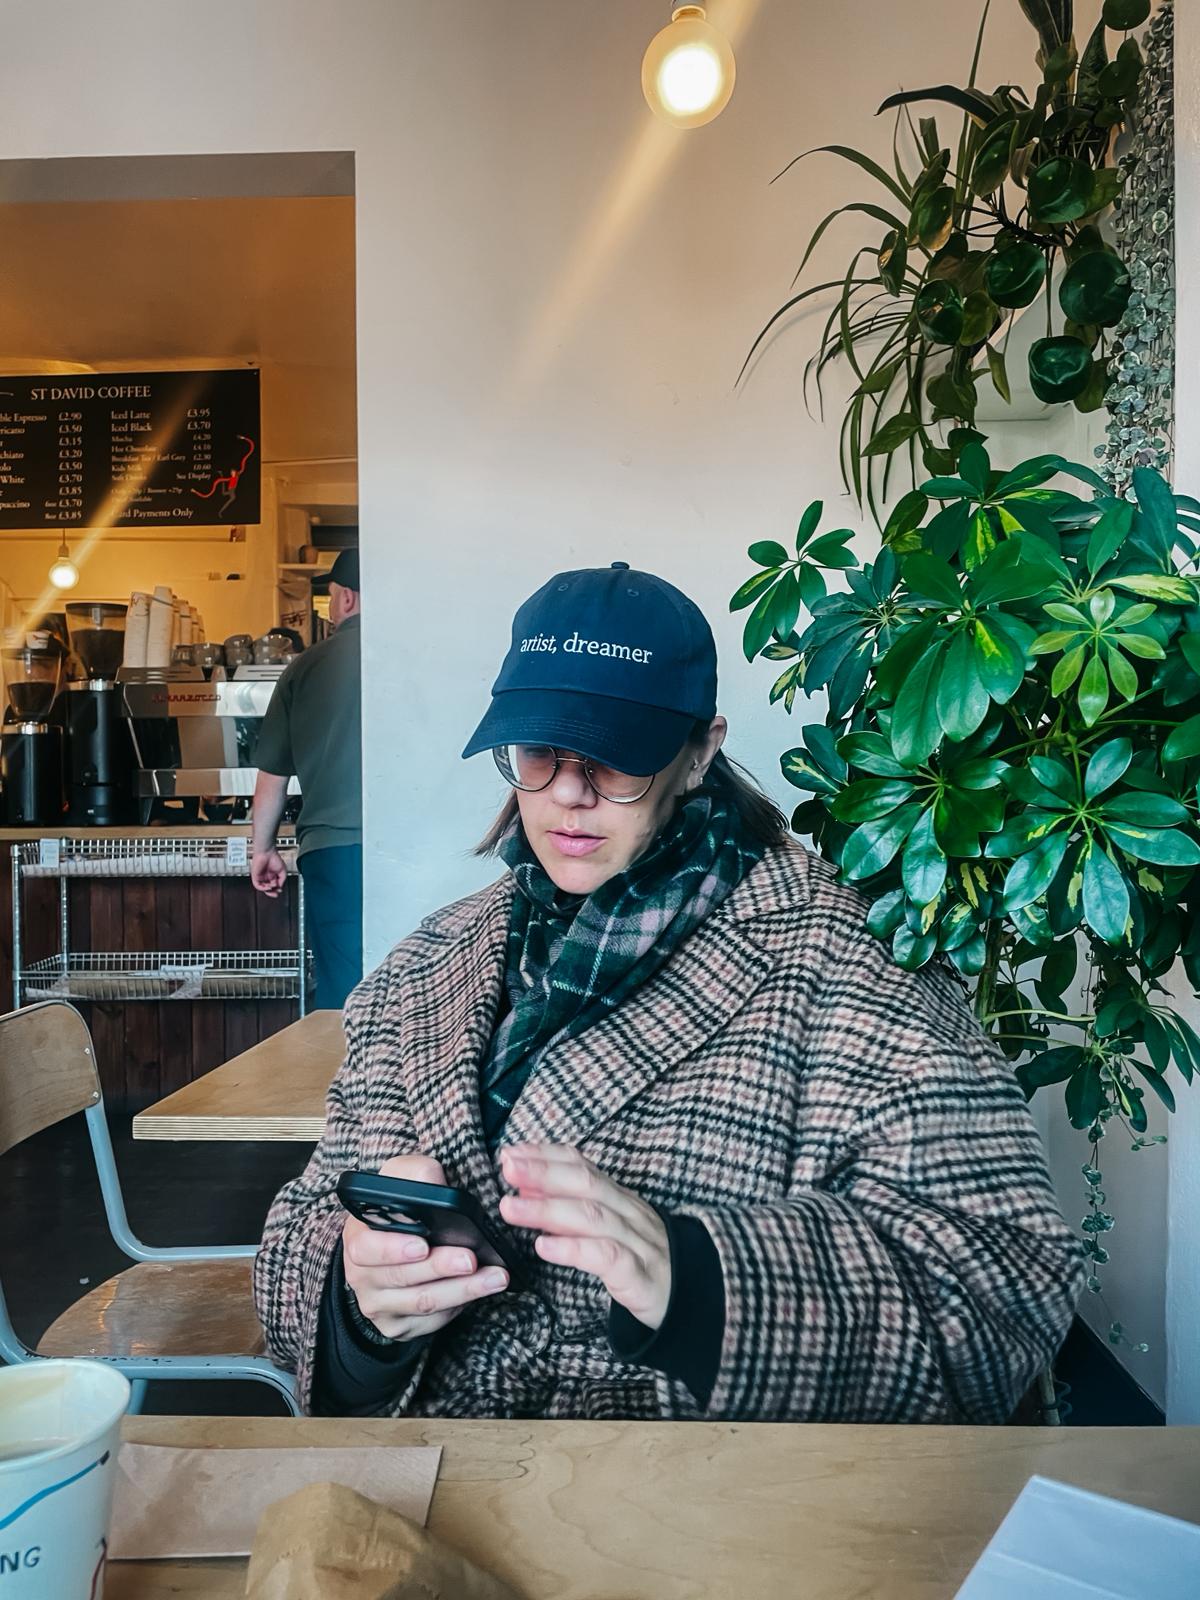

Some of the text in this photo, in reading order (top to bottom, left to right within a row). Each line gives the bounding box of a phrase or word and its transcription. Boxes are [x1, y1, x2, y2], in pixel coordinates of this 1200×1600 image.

[31, 385, 152, 400] ST DAVID COFFEE
[14, 412, 47, 424] Espresso
[59, 411, 82, 421] £2.90
[111, 408, 210, 419] Iced Latte £3.95
[59, 424, 82, 433] £3.50
[111, 421, 211, 432] Iced Black £3.70
[59, 437, 82, 446] £3.15
[59, 449, 82, 458] £3.20
[59, 461, 82, 470] £3.50
[0, 474, 82, 483] White £3.70
[59, 486, 82, 495] £3.85
[59, 499, 82, 507] £3.70
[59, 510, 82, 519] £3.85
[133, 508, 170, 519] Payments
[172, 507, 193, 518] Only
[520, 632, 653, 664] artist, dreamer
[0, 1546, 41, 1575] NG
